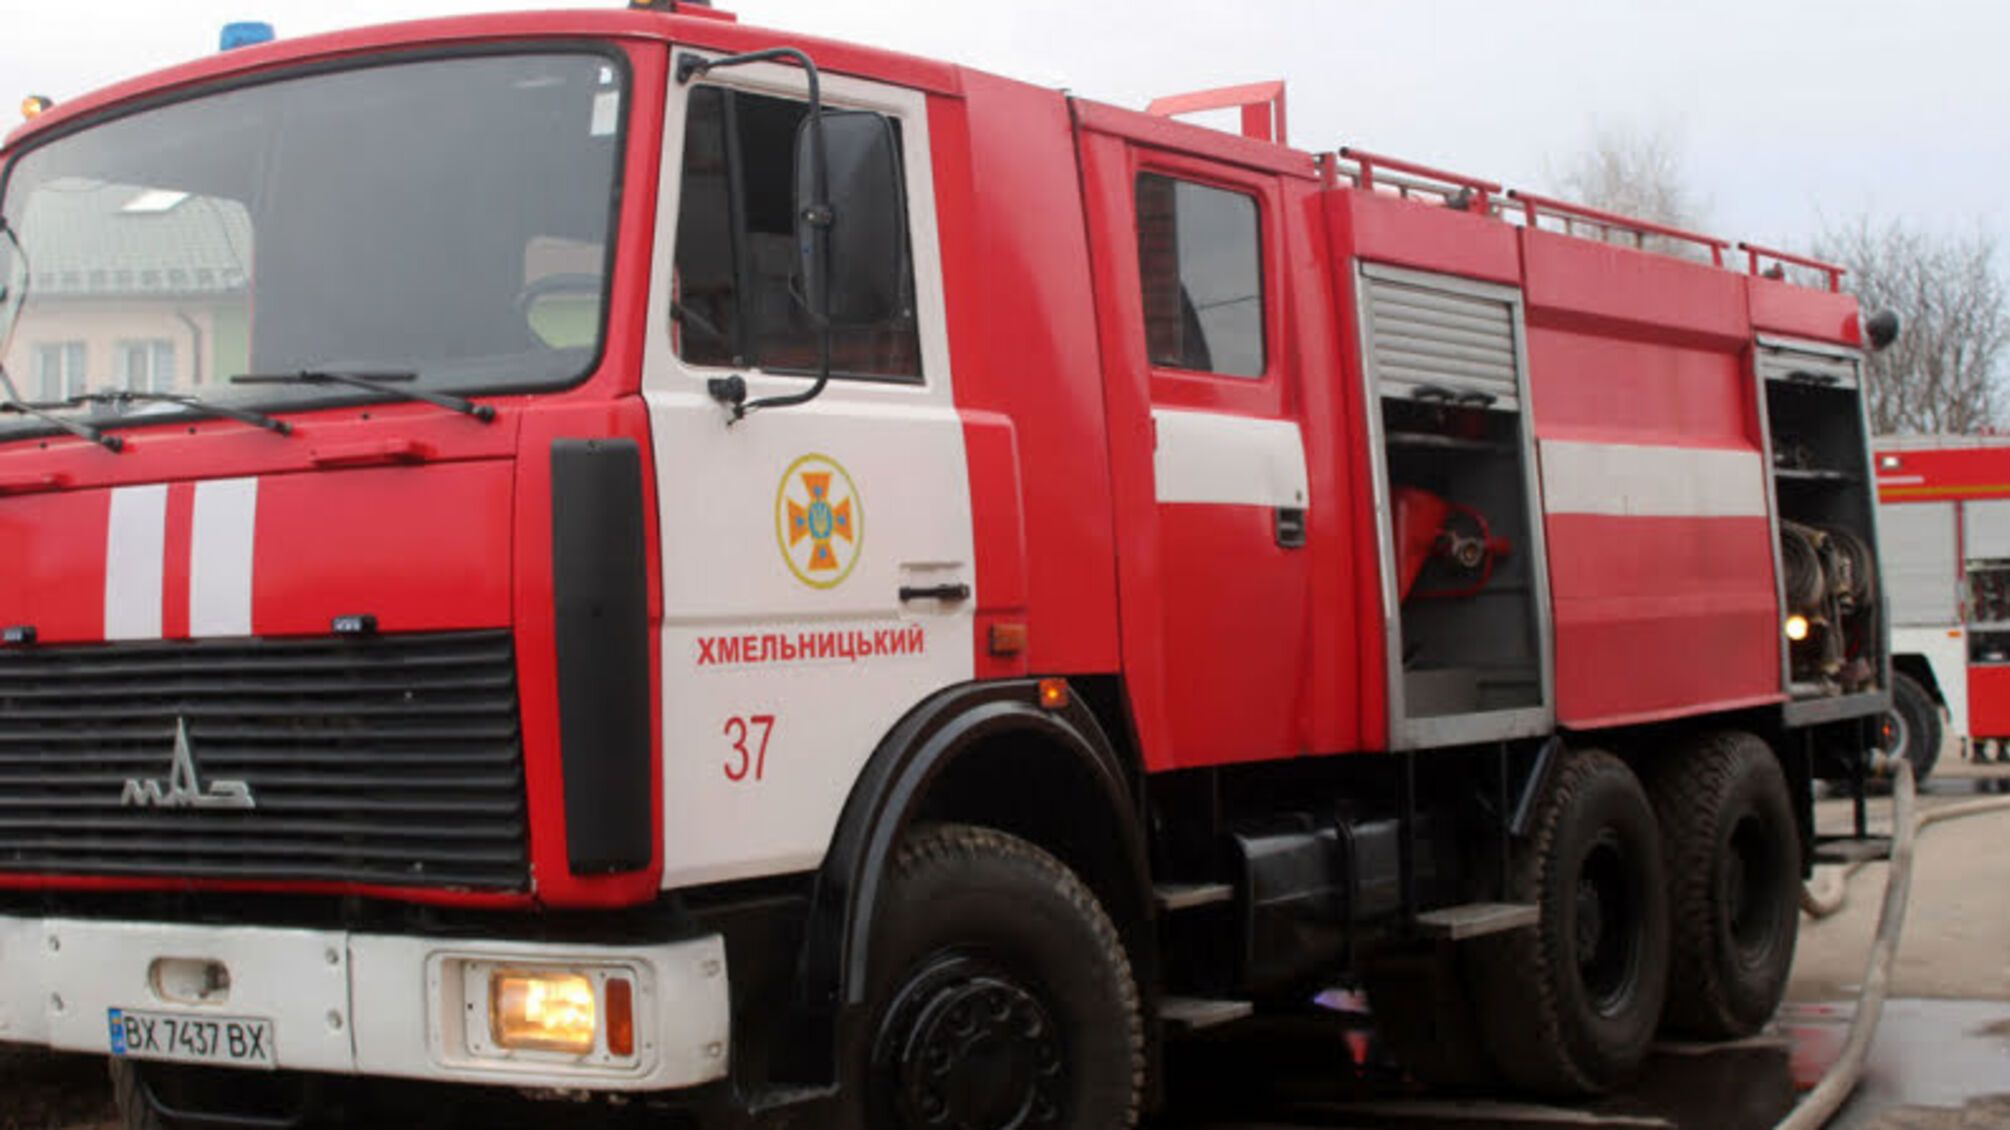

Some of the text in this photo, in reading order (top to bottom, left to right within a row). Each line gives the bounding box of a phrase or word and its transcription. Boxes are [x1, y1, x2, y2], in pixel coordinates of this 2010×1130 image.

[697, 624, 925, 665] ХМЕЛЬНИЦЬКИЙ
[723, 714, 776, 782] 37
[164, 1018, 219, 1056] 7437
